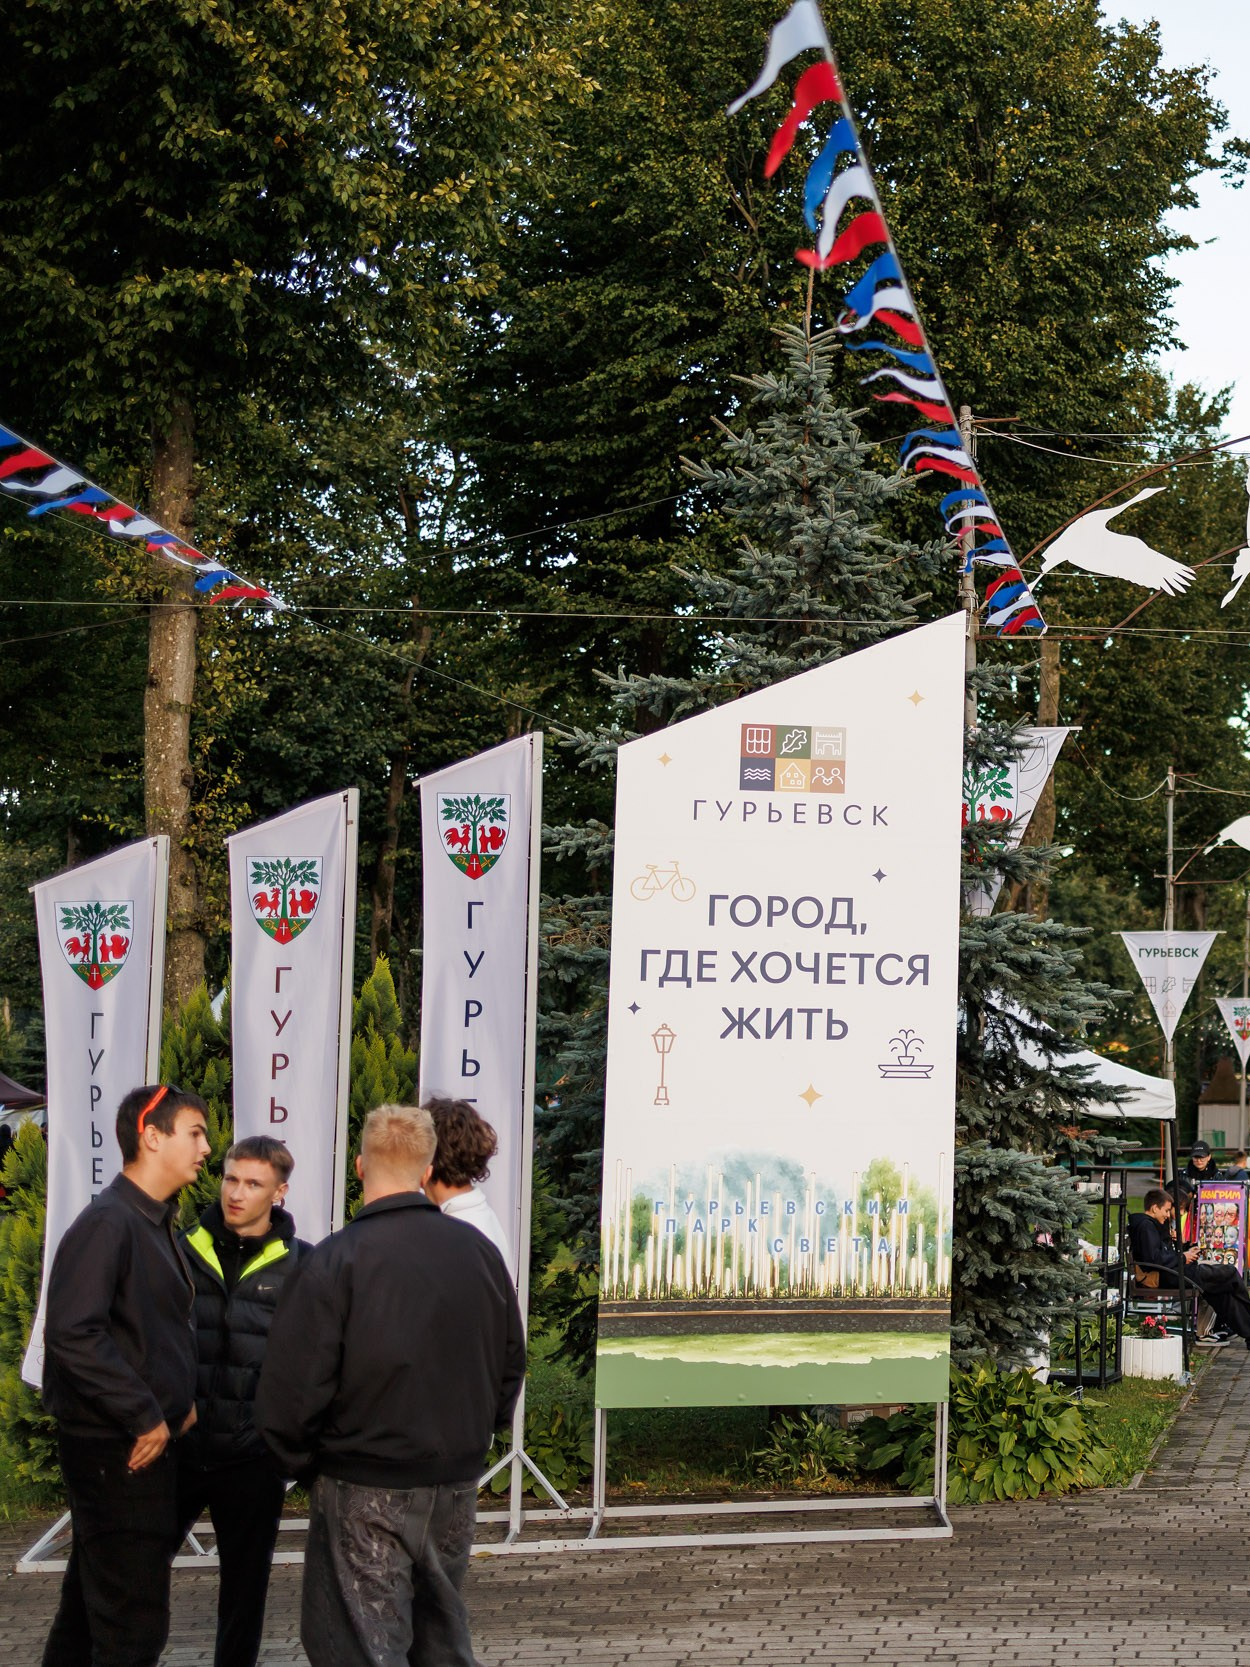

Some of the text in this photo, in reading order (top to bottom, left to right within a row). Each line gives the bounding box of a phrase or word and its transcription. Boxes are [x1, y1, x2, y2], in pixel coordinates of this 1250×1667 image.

[692, 799, 890, 827] ГУРЬЕВСК
[707, 893, 868, 936] ГОРОД,
[1137, 946, 1200, 959] ГУРЬЕВСК
[639, 948, 930, 989] ГДЕ ХОЧЕТСЯ
[460, 901, 485, 1103] ГУРЬ
[719, 1006, 849, 1041] ЖИТЬ
[268, 966, 293, 1144] ГУРЬ
[654, 1197, 910, 1217] ГУРЬЕВСКИЙ
[665, 1217, 760, 1235] ПАРК
[772, 1237, 890, 1255] СВЕТА
